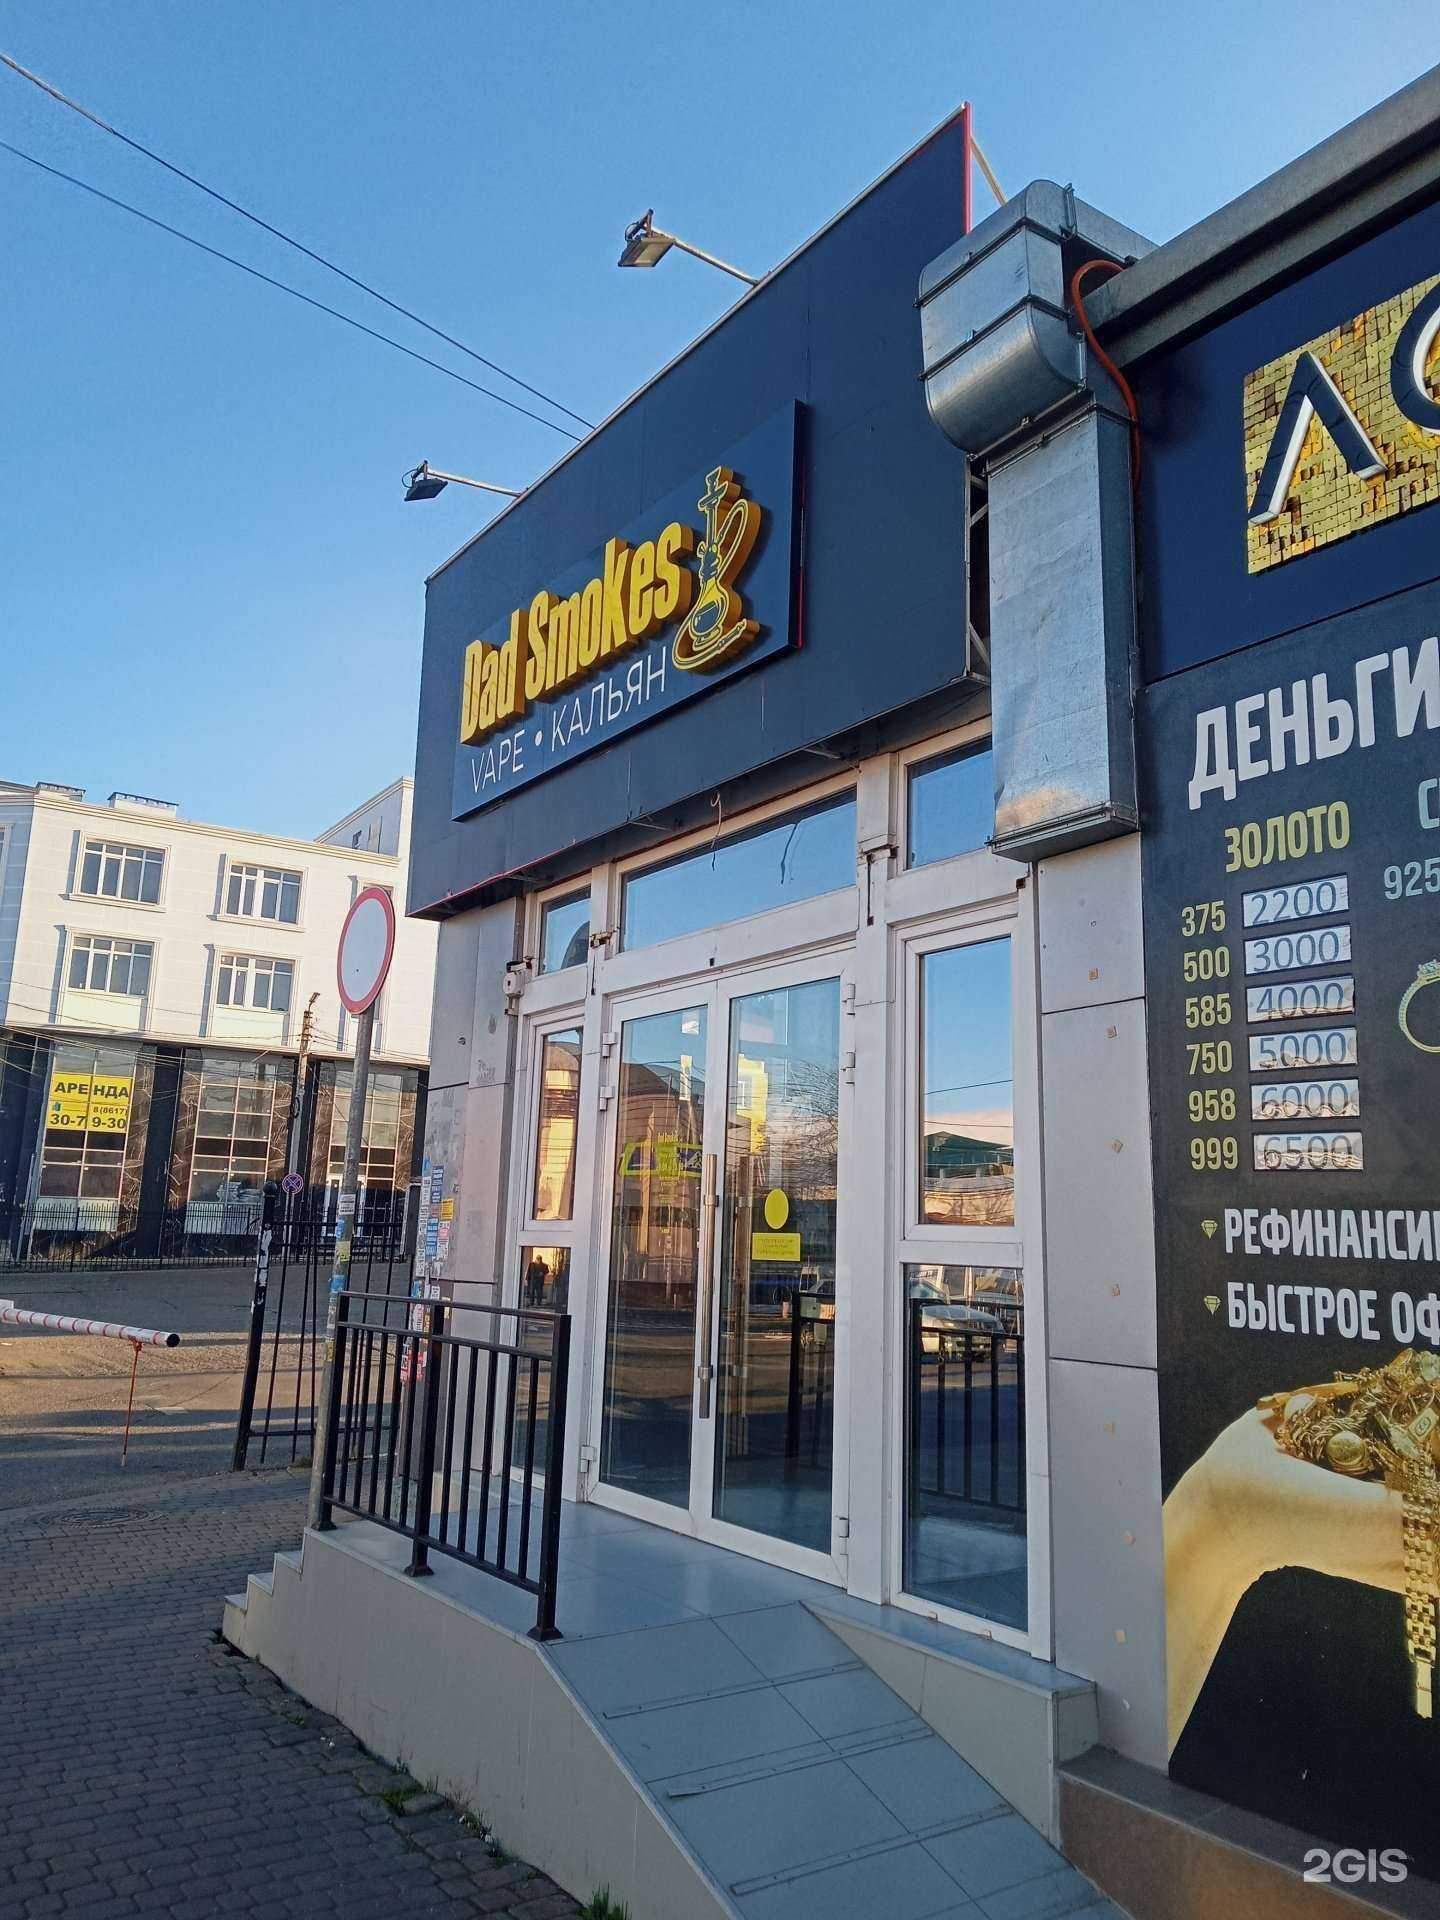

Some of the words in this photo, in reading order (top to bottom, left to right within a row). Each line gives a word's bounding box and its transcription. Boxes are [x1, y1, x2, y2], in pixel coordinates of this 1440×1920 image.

[459, 608, 526, 745] Dad
[471, 729, 526, 793] VAPE
[551, 645, 667, 752] КАЛЬЯН
[1188, 636, 1440, 810] ДЕНЬГИ
[1224, 801, 1350, 873] ЗОЛОТО
[1383, 857, 1440, 900] 925
[1182, 901, 1226, 937] 375
[1251, 881, 1337, 925] 2200
[1183, 947, 1230, 982] 500
[1253, 931, 1340, 972] 3000
[1185, 993, 1232, 1029] 585
[1256, 982, 1344, 1019] 4000
[1186, 1040, 1233, 1075] 750
[1259, 1031, 1347, 1067] 5000
[1188, 1088, 1236, 1122] 958
[1190, 1137, 1239, 1170] 999
[1227, 1281, 1381, 1341] БЫСТРОЕ
